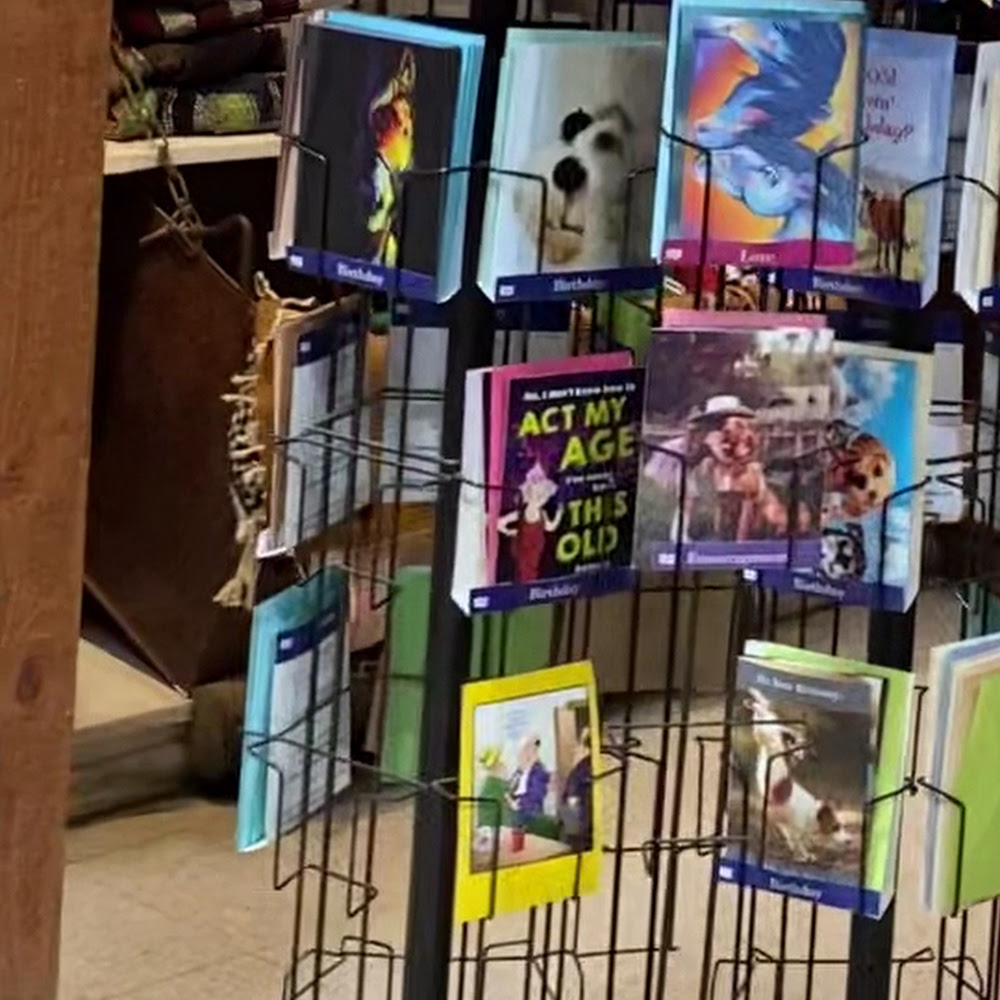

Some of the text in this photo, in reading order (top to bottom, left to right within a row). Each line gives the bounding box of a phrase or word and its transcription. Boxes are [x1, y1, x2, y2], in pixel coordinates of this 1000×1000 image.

[336, 261, 385, 286] Birthday
[518, 395, 628, 438] ACT MY
[559, 424, 636, 473] AGE
[568, 490, 629, 528] THIS
[555, 524, 619, 563] OLD
